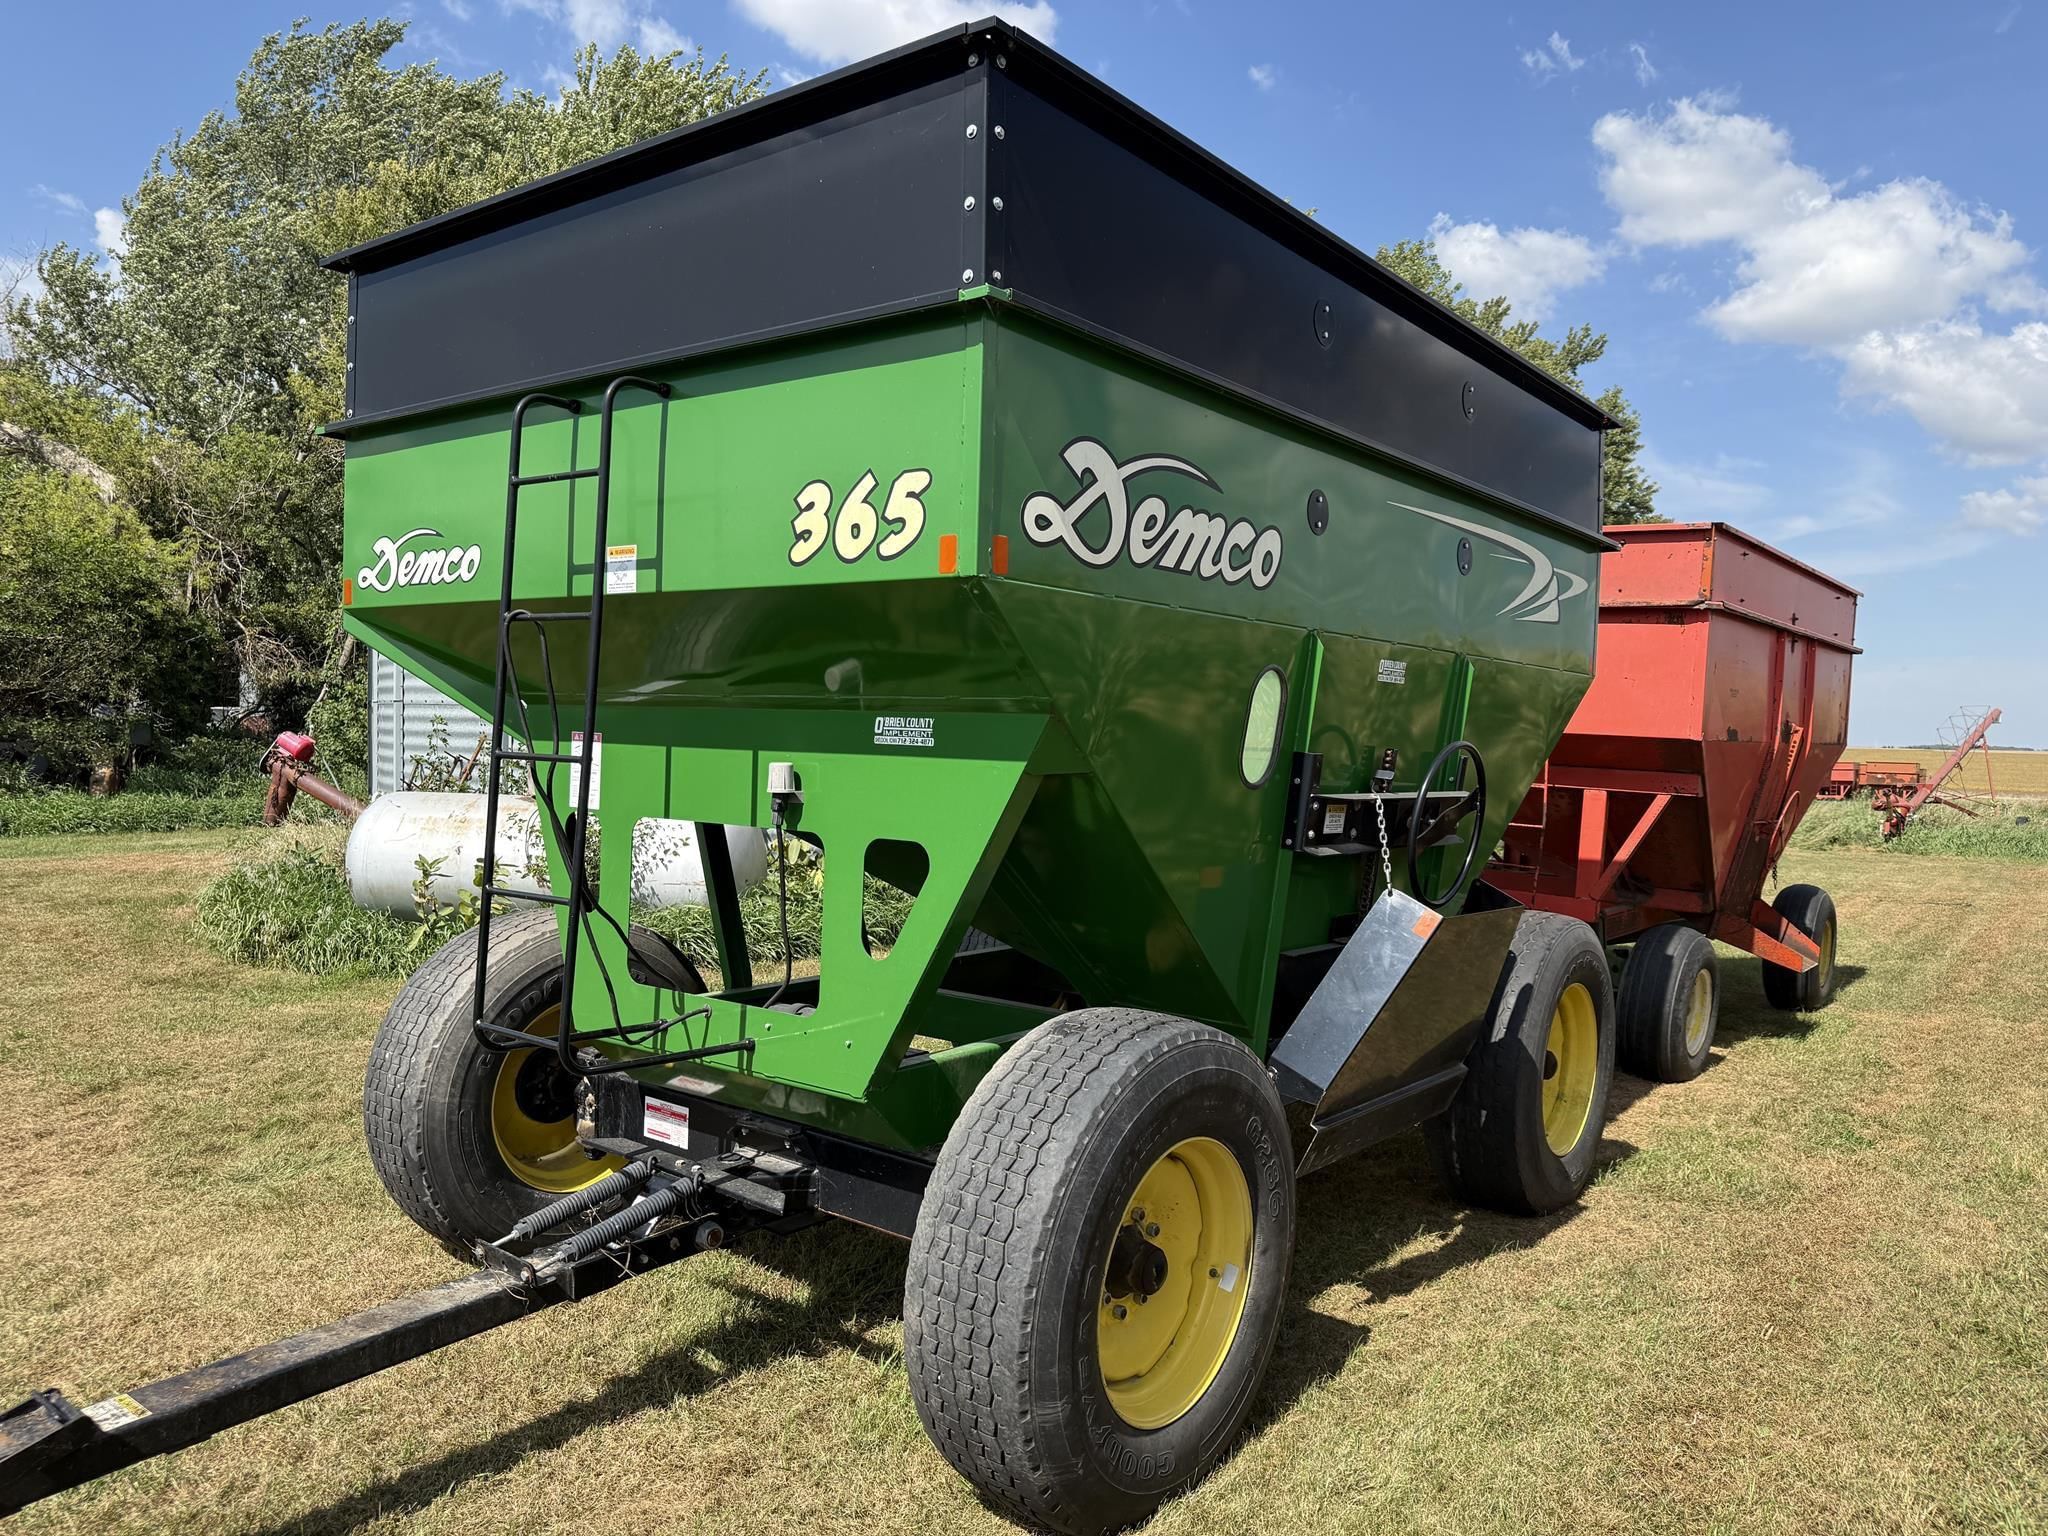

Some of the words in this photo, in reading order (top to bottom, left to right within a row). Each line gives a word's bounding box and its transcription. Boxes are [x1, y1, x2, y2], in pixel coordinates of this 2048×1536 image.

[788, 468, 932, 567] 365
[1021, 436, 1283, 591] Demco
[358, 528, 482, 594] Demco
[874, 717, 905, 733] O'BRIEN
[905, 717, 935, 728] COUNTY
[883, 730, 933, 738] IMPLEMENT
